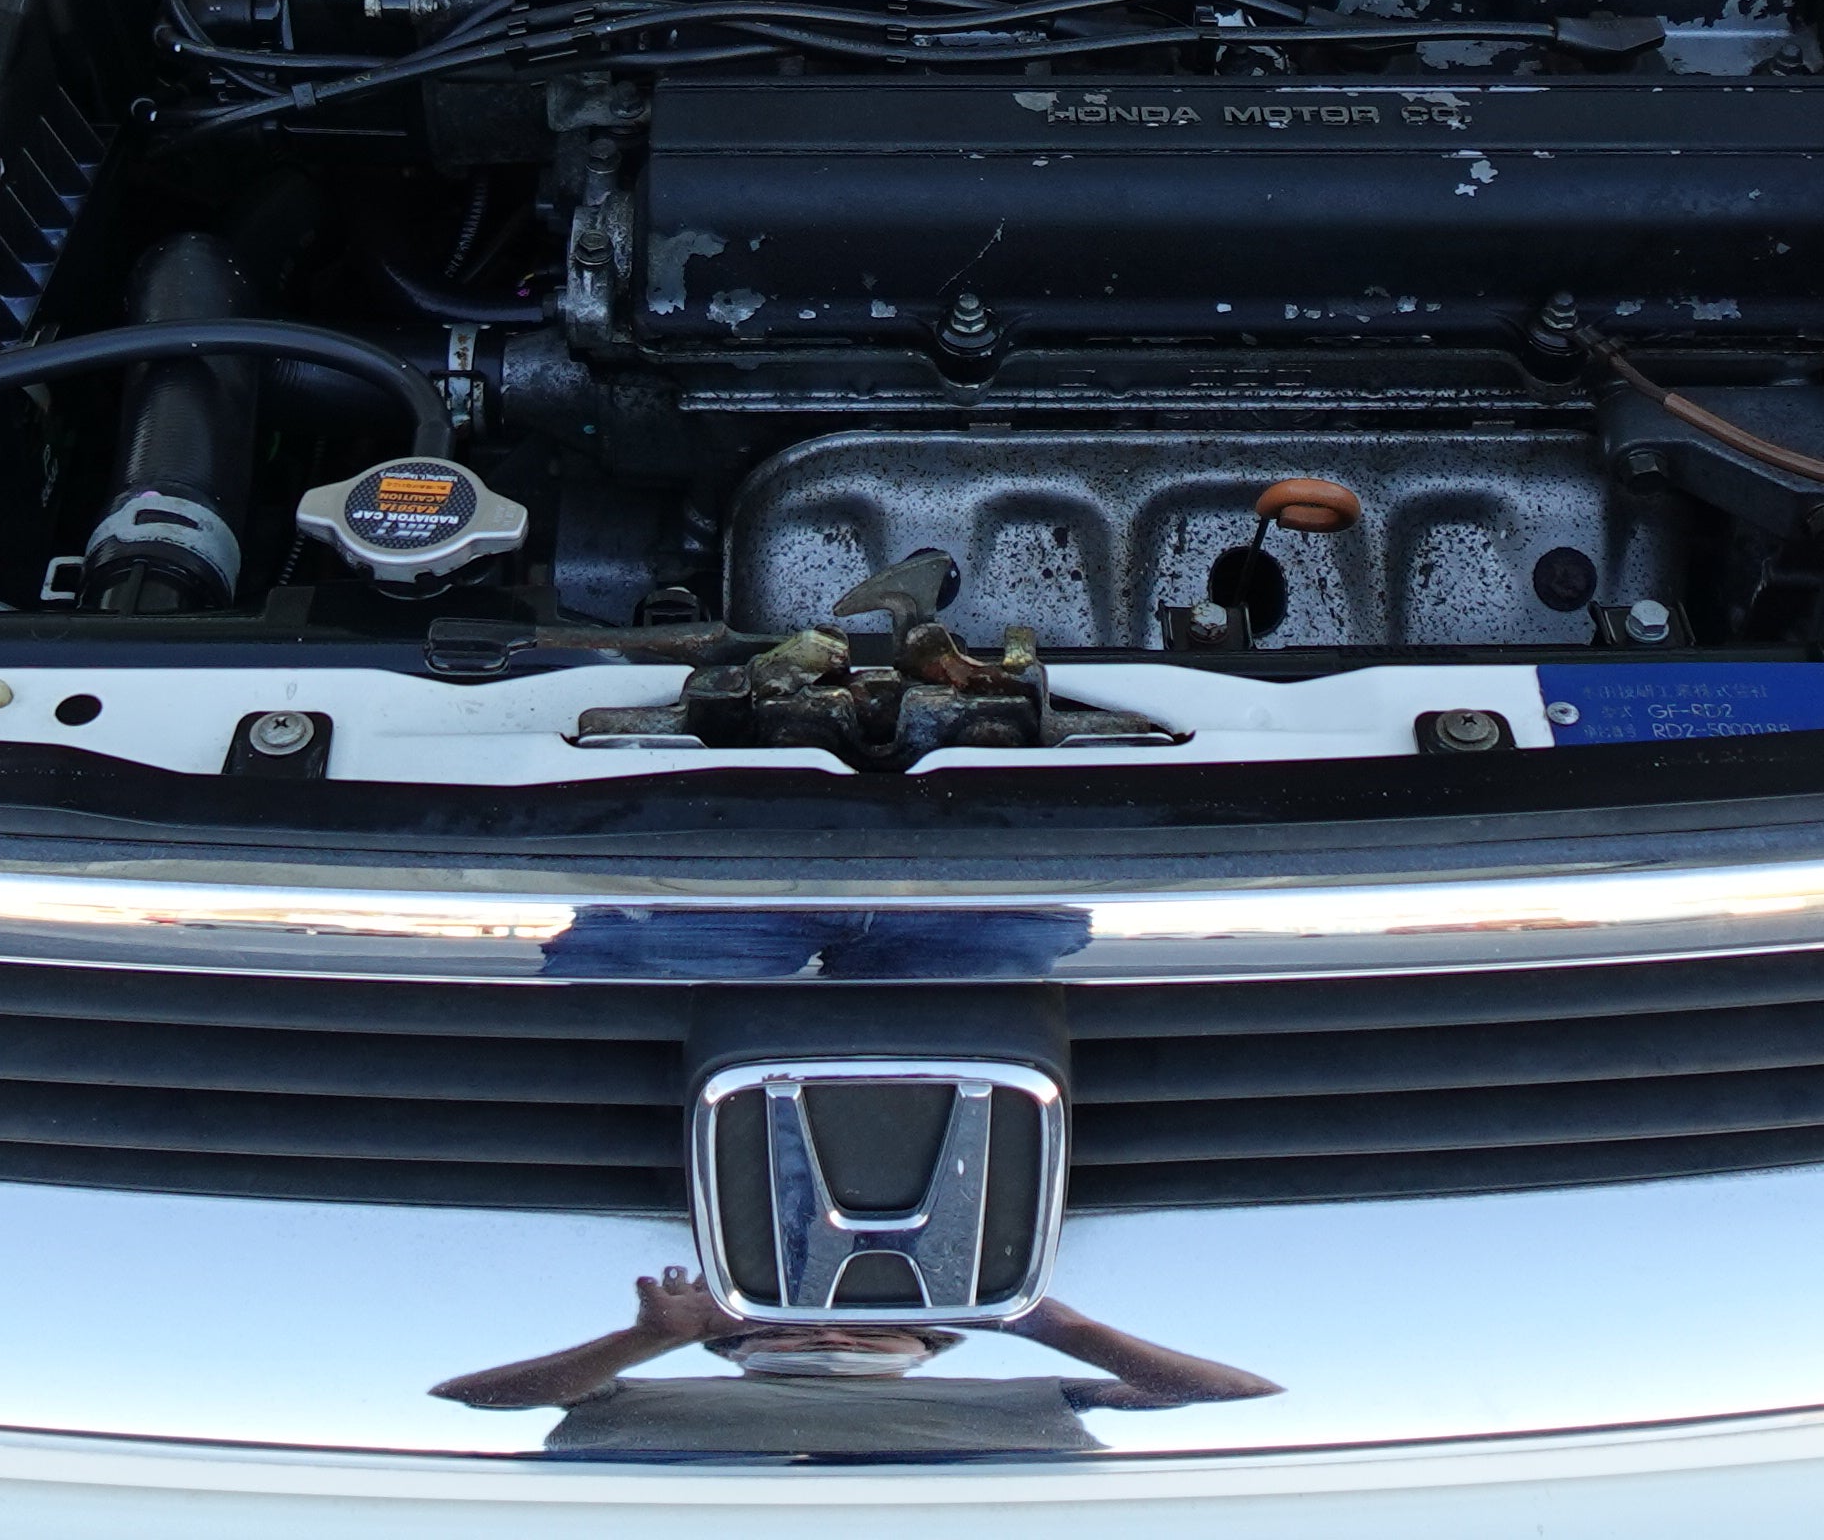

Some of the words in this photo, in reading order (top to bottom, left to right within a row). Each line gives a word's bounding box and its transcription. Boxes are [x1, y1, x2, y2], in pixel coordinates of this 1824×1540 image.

[1047, 105, 1202, 125] HONDA
[1222, 106, 1381, 126] MOTOR
[379, 493, 435, 502] CAUTION
[351, 510, 384, 520] CAP
[387, 512, 460, 524] RADIATOR
[1647, 703, 1733, 719] GF-RD2
